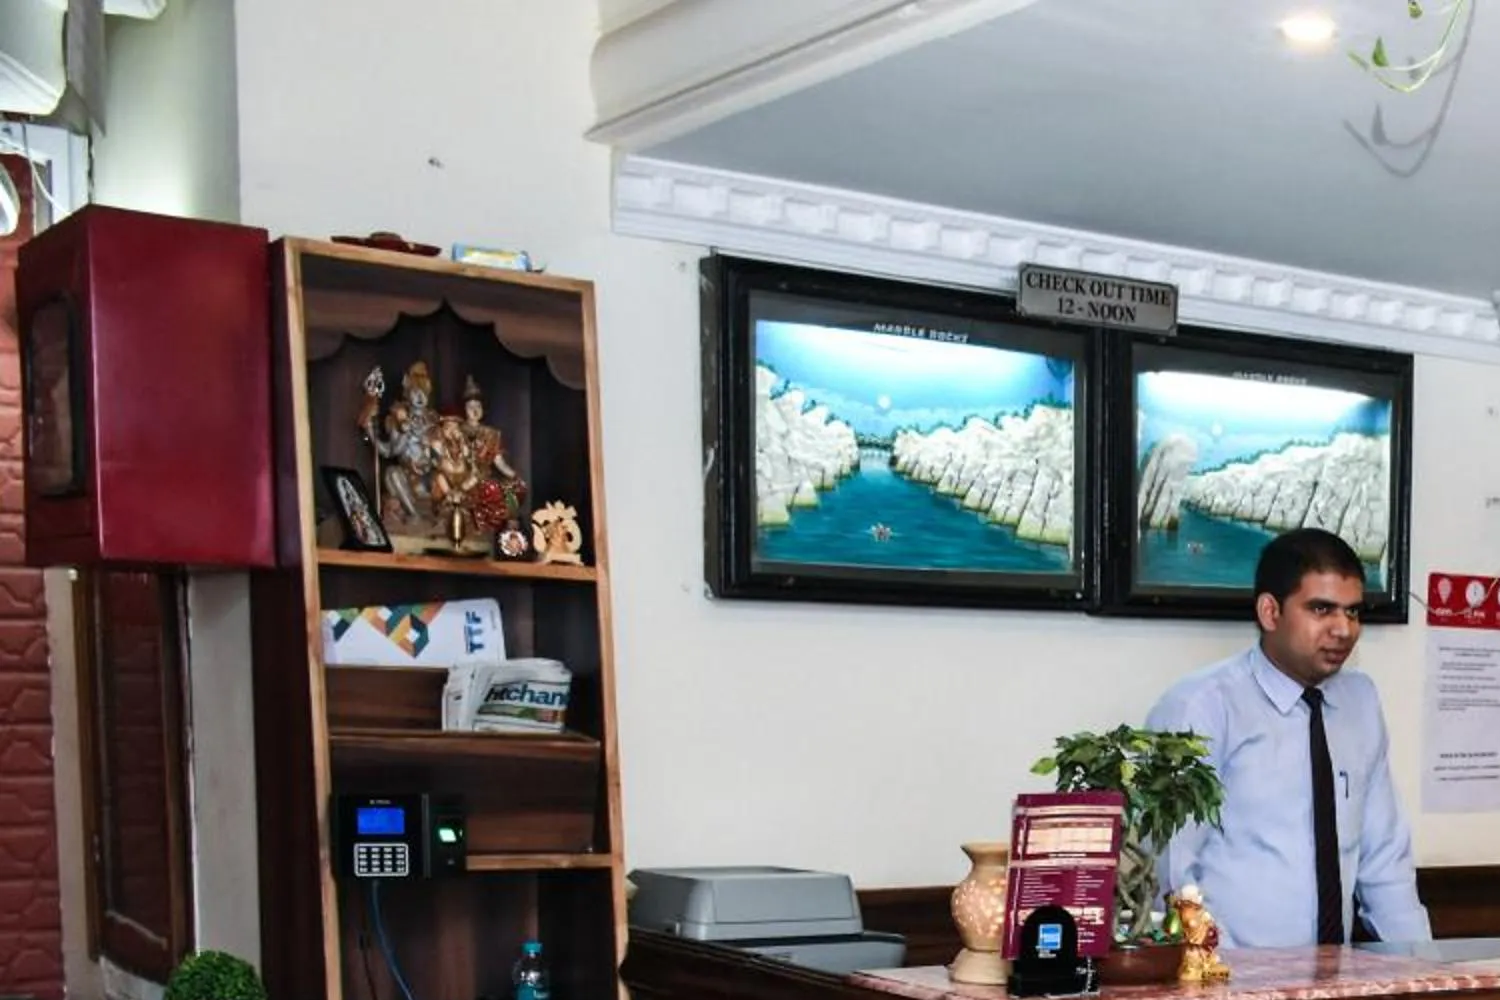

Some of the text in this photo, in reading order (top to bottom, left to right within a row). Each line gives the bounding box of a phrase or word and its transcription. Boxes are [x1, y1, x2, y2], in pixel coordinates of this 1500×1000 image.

[1026, 271, 1171, 307] CHECK OUT TIME
[1058, 298, 1075, 314] 12
[1088, 302, 1137, 323] NOON
